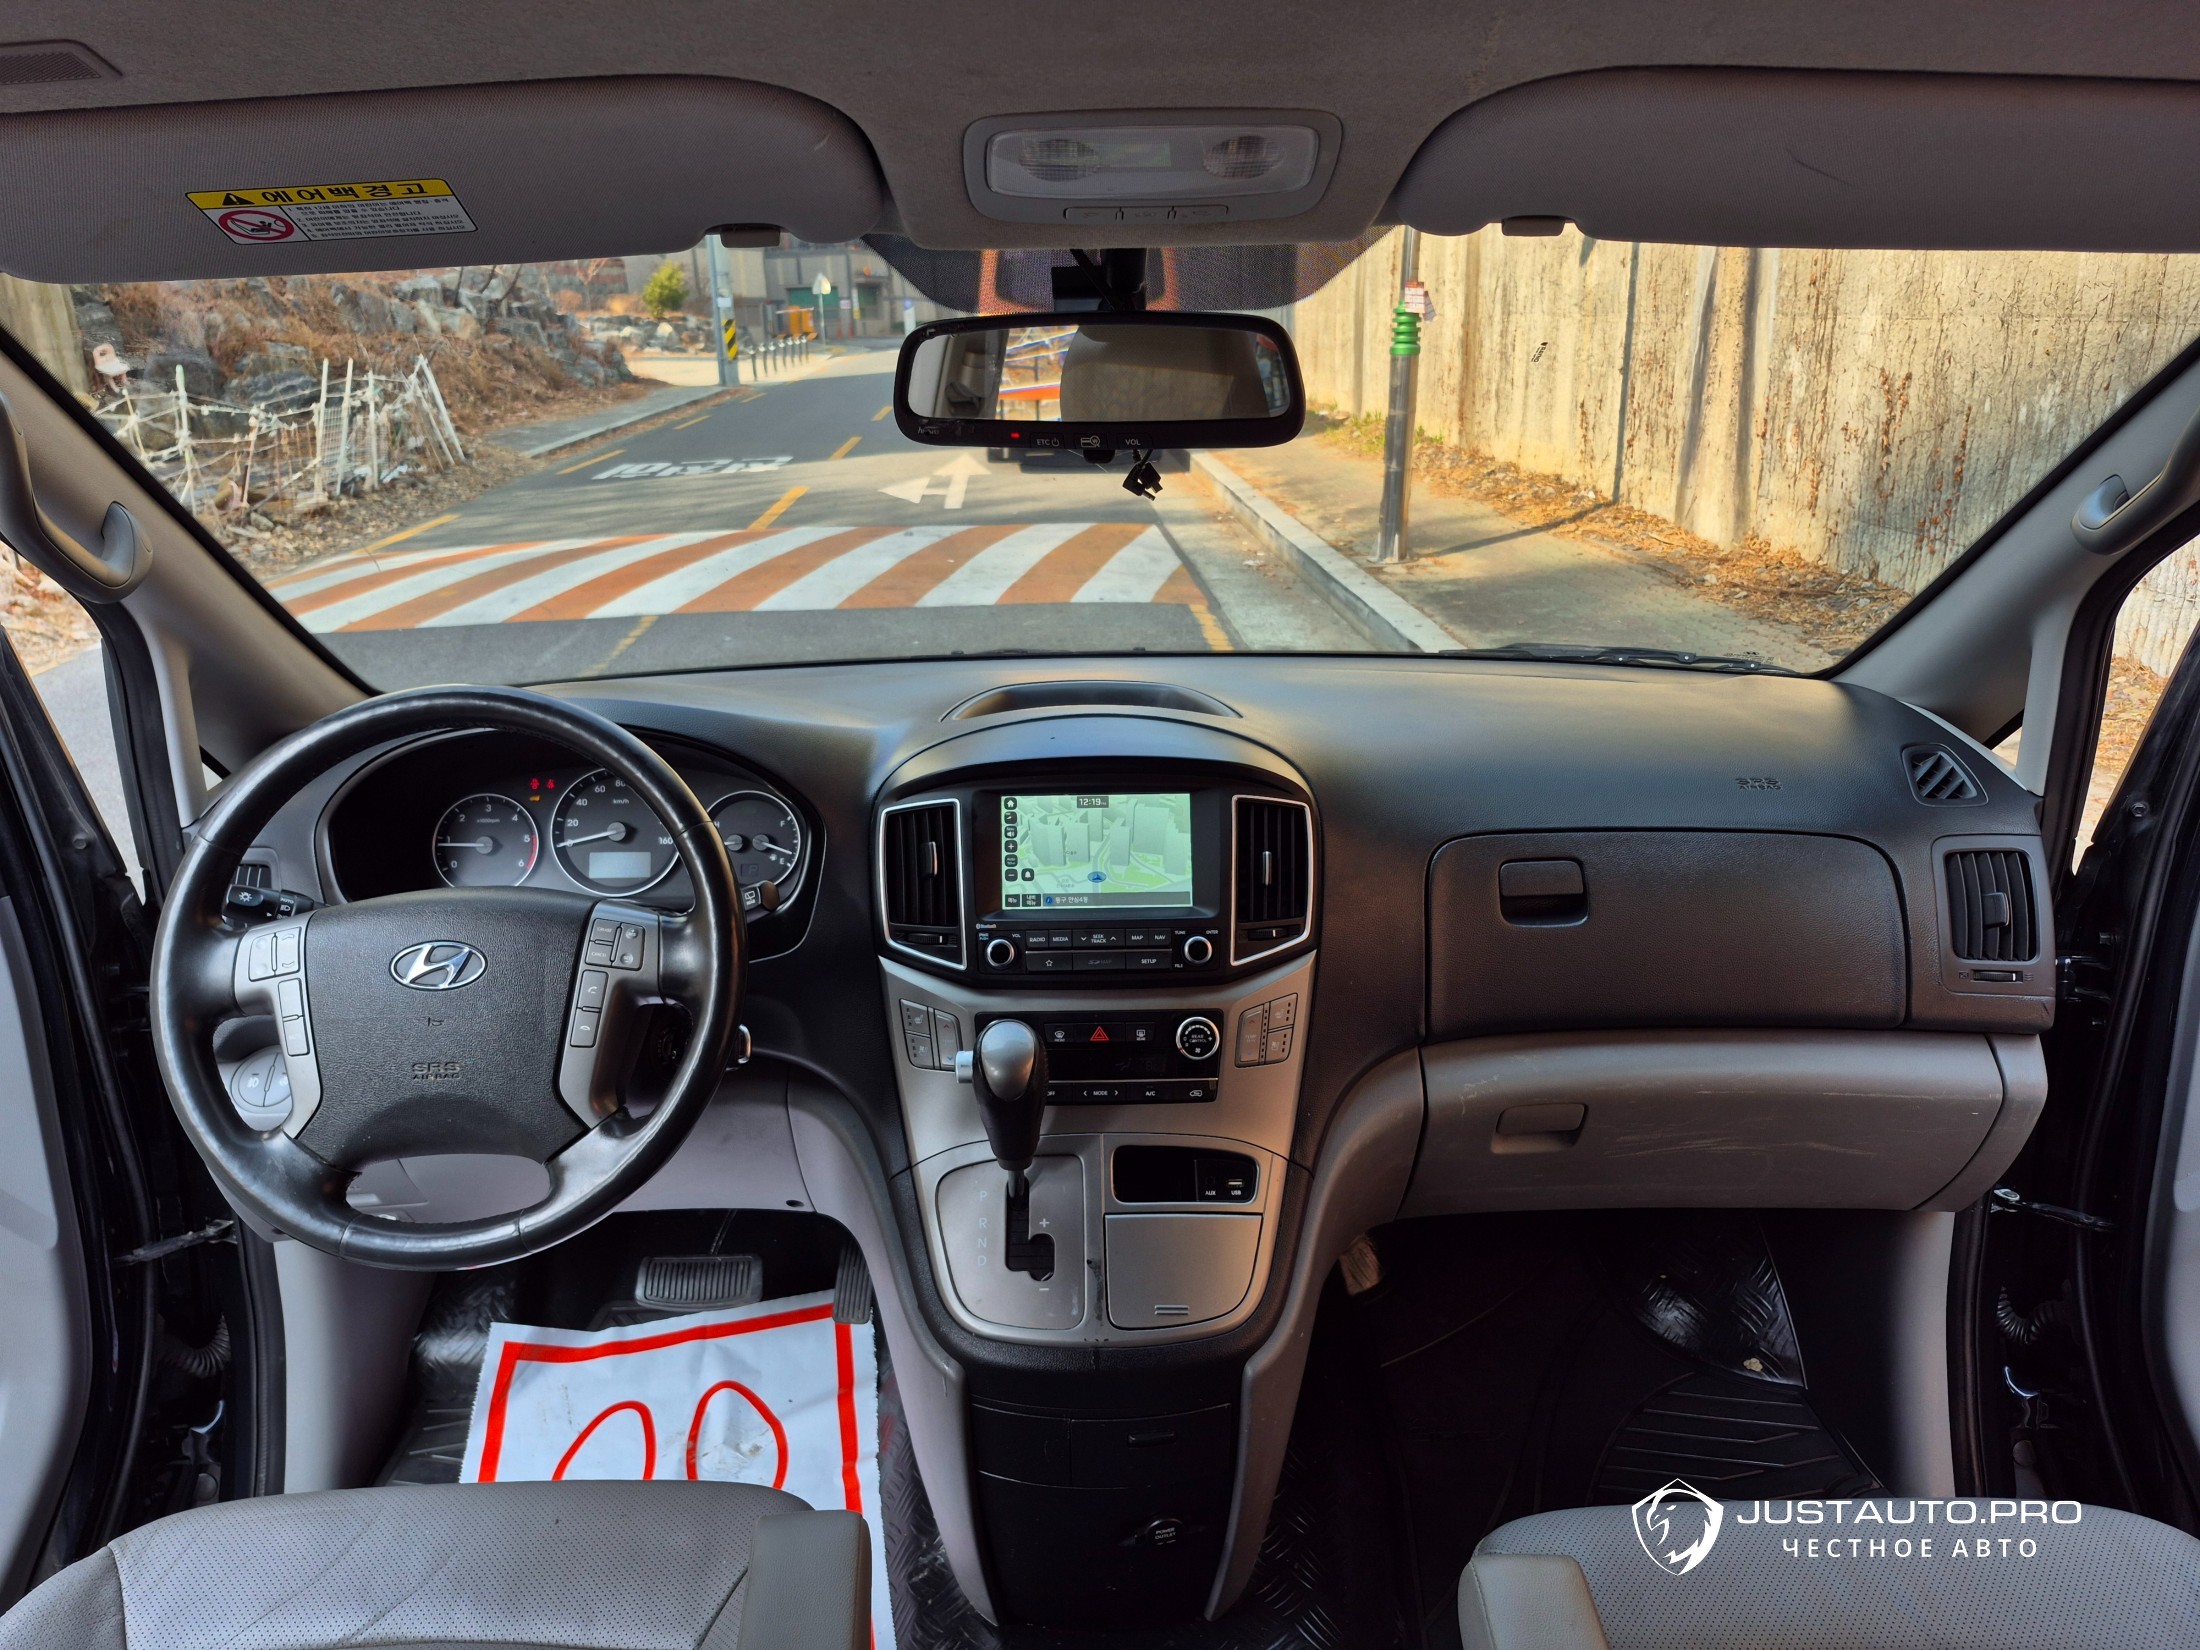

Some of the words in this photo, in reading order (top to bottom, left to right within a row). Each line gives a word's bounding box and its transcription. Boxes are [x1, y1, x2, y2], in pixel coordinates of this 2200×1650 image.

[1079, 798, 1101, 806] 12:19
[486, 804, 492, 812] 3
[659, 836, 674, 844] 160
[518, 860, 524, 868] 6
[412, 1062, 461, 1073] SRS
[980, 1190, 987, 1201] P
[979, 1218, 988, 1228] R
[978, 1238, 986, 1248] N
[978, 1255, 986, 1266] D
[1155, 1527, 1175, 1535] POWER
[1154, 1532, 1176, 1540] OUTLET
